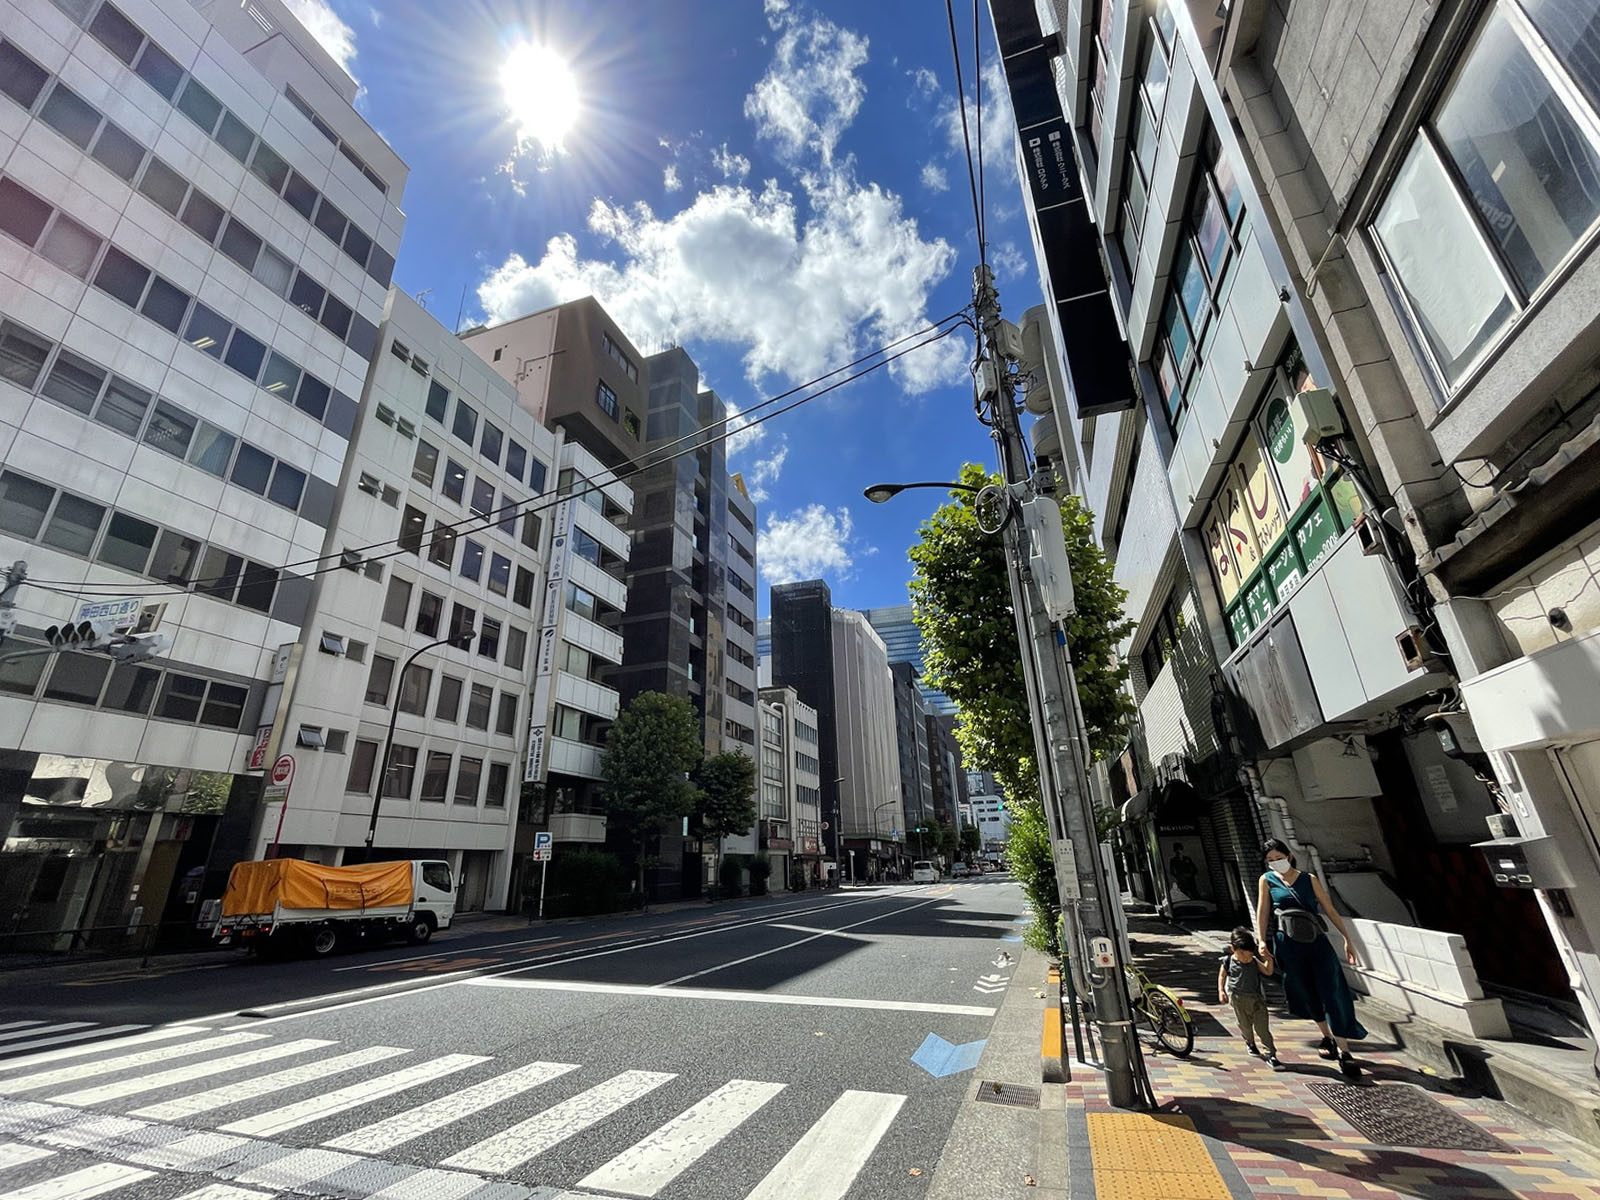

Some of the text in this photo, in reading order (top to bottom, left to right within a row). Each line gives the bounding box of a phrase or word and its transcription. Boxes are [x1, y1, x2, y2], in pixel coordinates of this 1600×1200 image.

[81, 601, 139, 619] 神田西口通り
[536, 833, 550, 848] P
